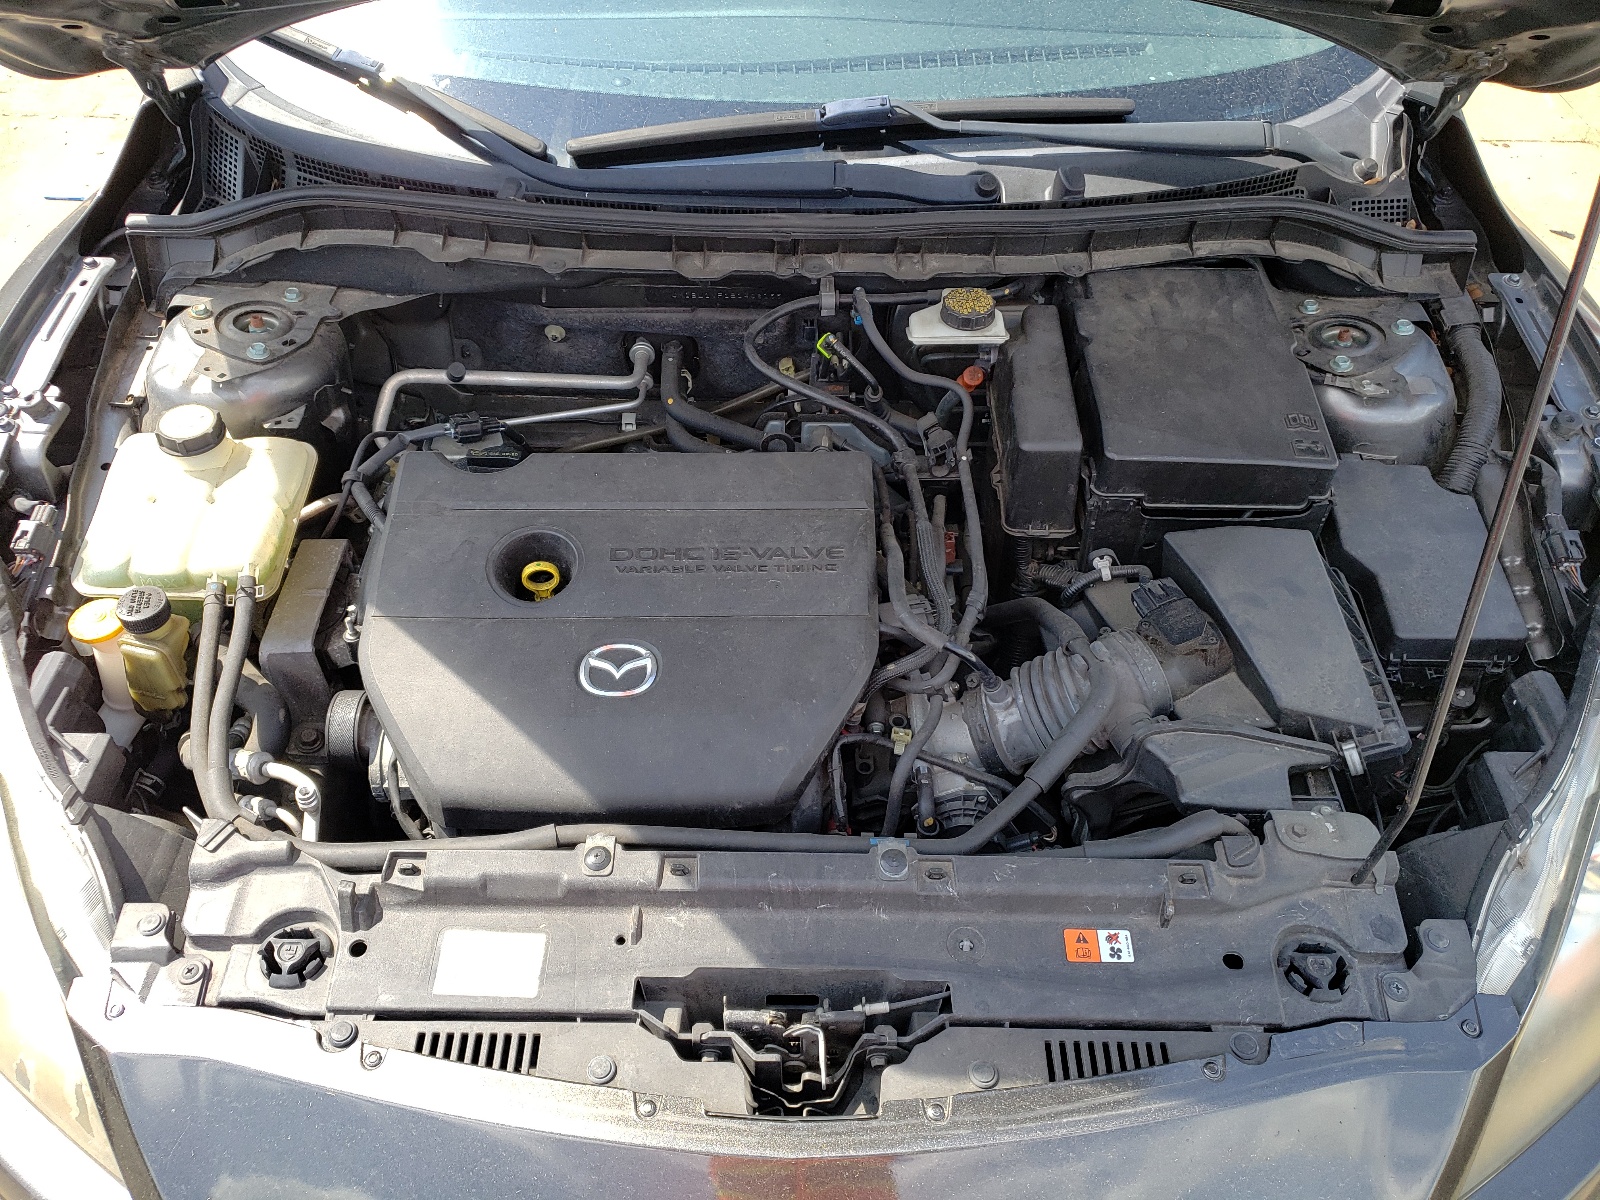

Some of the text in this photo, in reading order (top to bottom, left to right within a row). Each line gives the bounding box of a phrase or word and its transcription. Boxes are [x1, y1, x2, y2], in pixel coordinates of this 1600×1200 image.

[609, 546, 704, 562] DOHC
[614, 564, 706, 574] VARIABLE
[711, 564, 768, 574] VALVE
